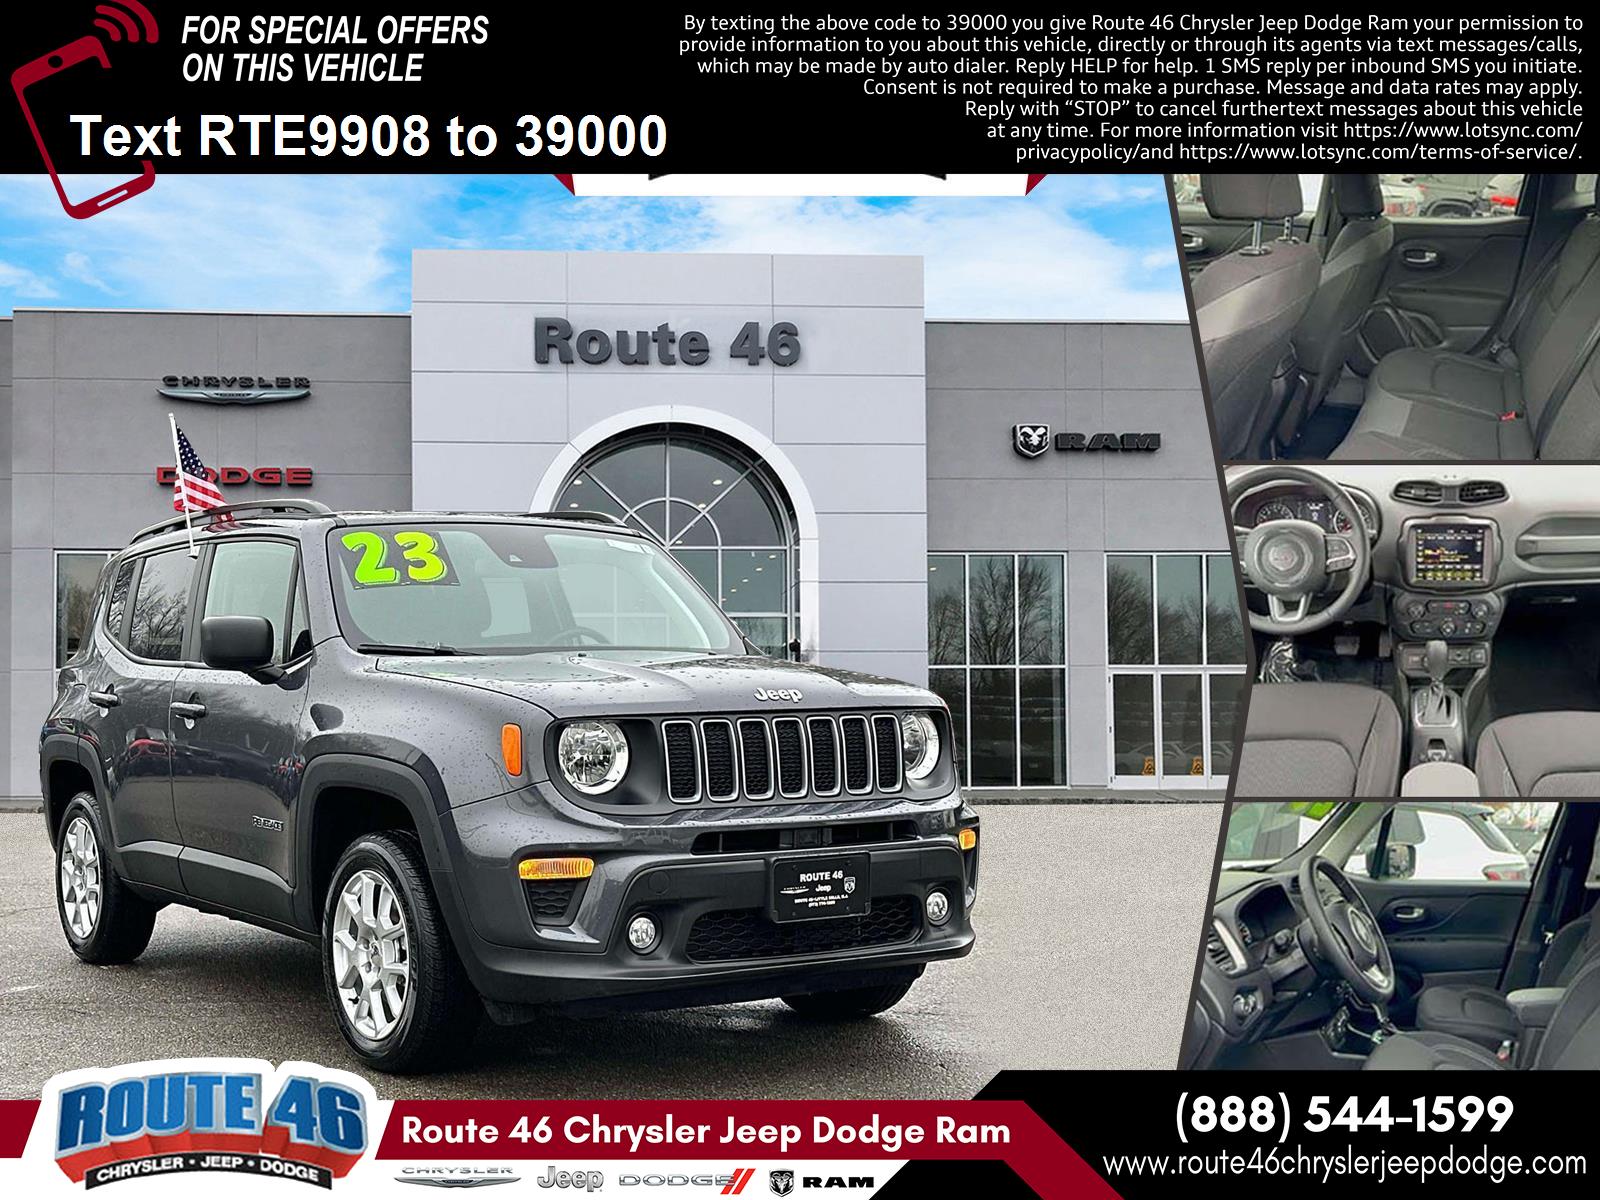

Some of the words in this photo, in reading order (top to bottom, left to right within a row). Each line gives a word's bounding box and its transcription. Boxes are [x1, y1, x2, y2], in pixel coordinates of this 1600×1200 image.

[534, 316, 710, 366] Route
[729, 320, 802, 367] 46
[161, 375, 312, 389] CHRYSLER
[1055, 432, 1162, 452] RAM
[341, 530, 449, 586] 23
[753, 687, 803, 703] Jeep
[799, 873, 831, 882] ROUTE
[832, 870, 844, 880] 46
[815, 884, 832, 893] Jeep
